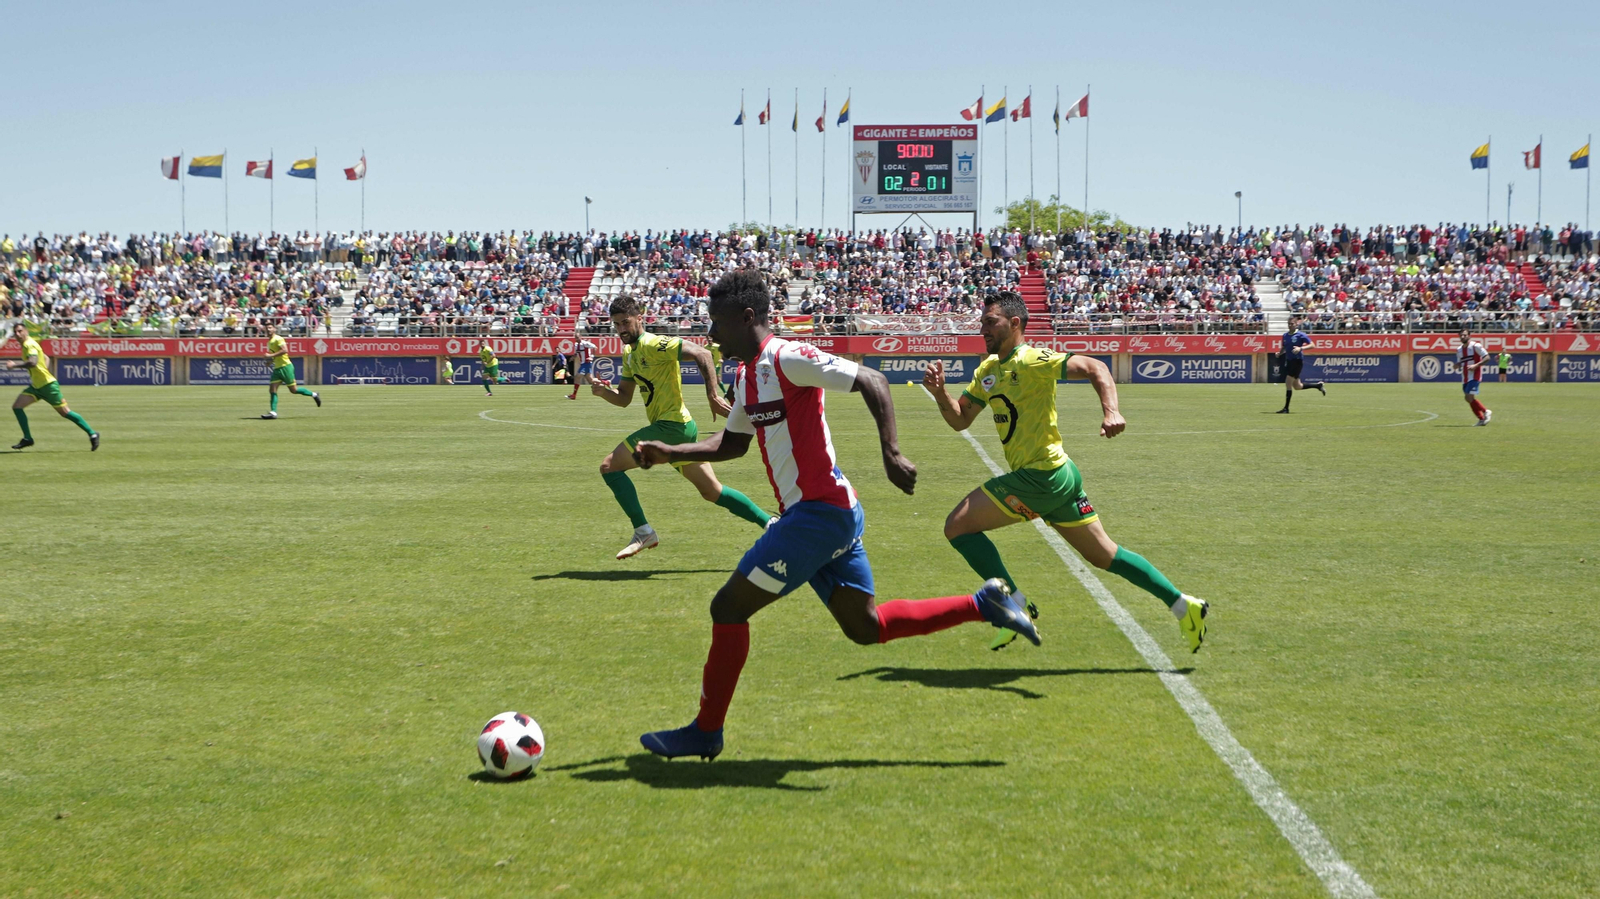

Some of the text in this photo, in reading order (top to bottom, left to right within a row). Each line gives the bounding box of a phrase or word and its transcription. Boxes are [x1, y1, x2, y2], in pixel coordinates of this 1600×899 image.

[863, 128, 908, 138] GIGANTE
[918, 126, 974, 138] EMPEÑOS
[884, 175, 903, 191] 02
[910, 171, 920, 187] 2
[927, 175, 946, 191] 01
[956, 324, 981, 332] CORA
[334, 341, 400, 351] Llavenmano
[466, 339, 553, 354] PDILLA
[907, 336, 958, 345] HYUNDAI
[1335, 337, 1401, 349] ALBORÁN
[85, 340, 166, 354] yovigilo.com
[178, 341, 307, 353] Mercure HEL
[907, 345, 958, 353] PERMOTOR
[240, 359, 274, 367] CLÍNIC
[1182, 359, 1246, 370] HYUNDAI
[1182, 370, 1246, 380] PERMOTOR
